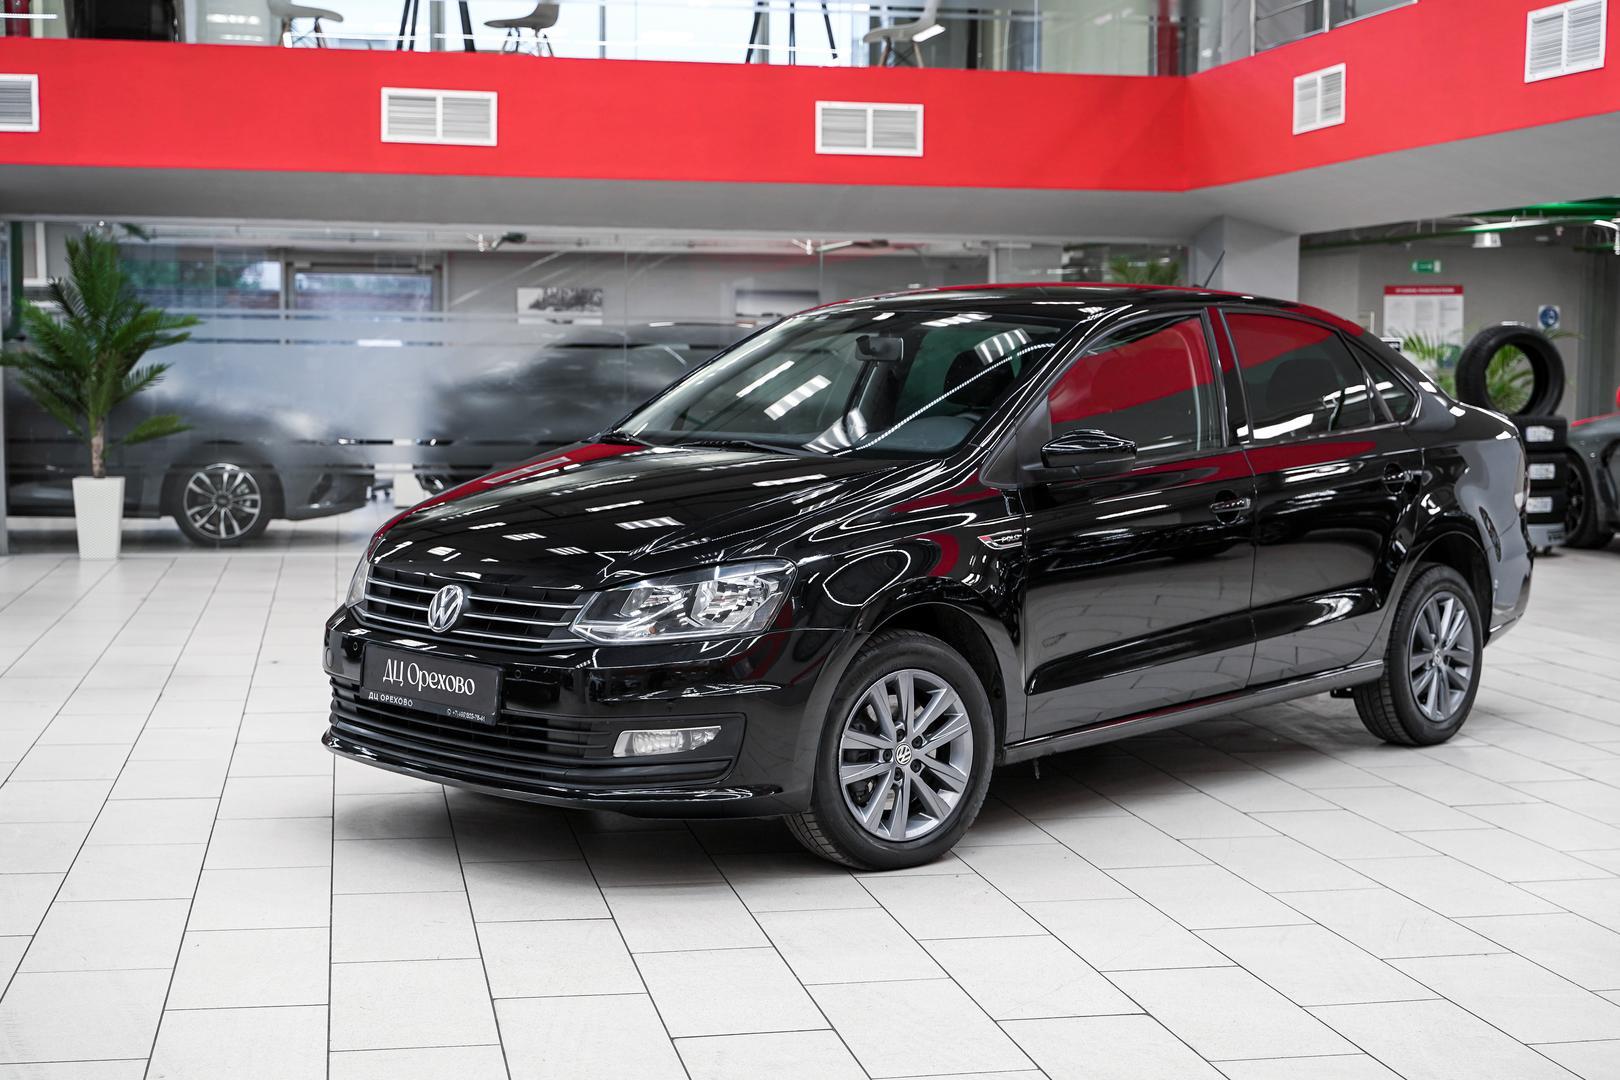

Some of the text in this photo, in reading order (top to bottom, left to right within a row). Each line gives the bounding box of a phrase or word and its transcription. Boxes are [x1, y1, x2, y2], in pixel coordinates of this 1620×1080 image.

[382, 659, 475, 696] ДЦ Орехово
[368, 691, 413, 707] ДЦ ОРЕХОВО
